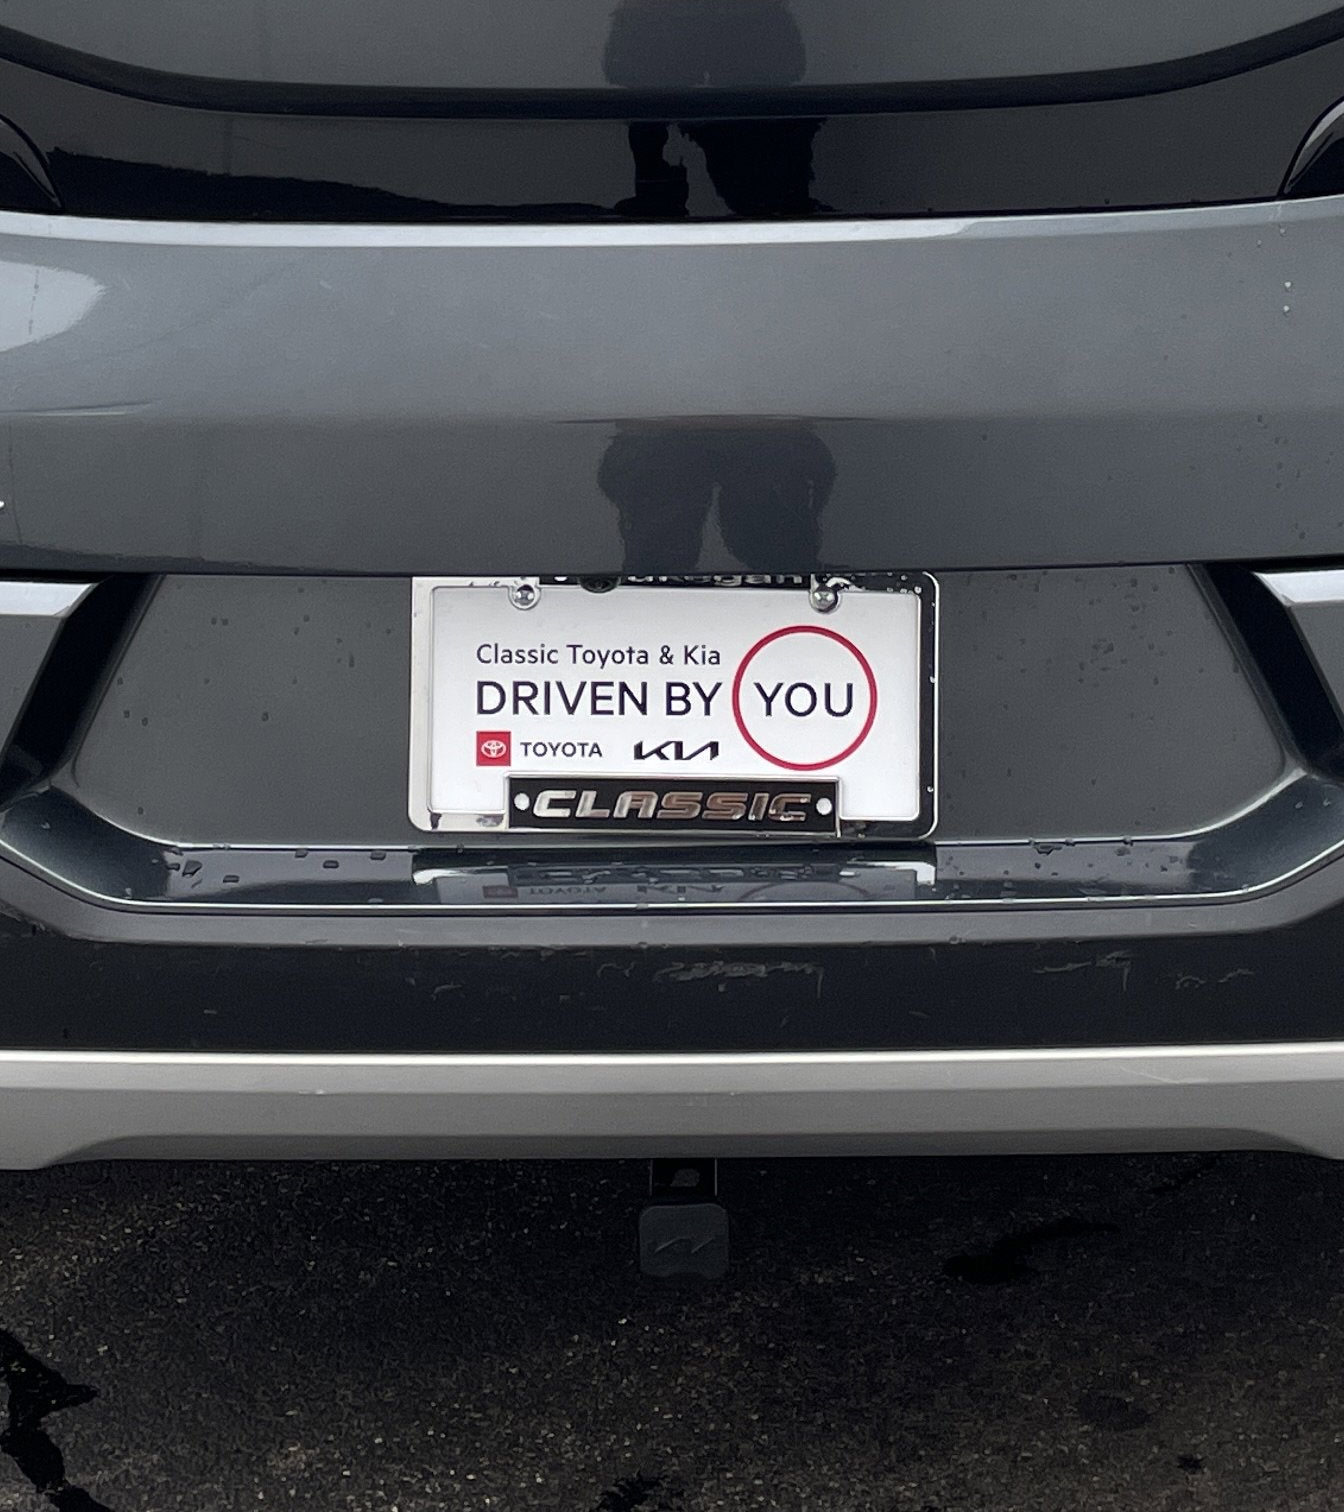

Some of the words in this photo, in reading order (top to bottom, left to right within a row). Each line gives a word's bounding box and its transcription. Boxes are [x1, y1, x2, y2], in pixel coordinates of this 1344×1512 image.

[476, 643, 559, 665] Classic
[566, 644, 649, 670] Toyota
[659, 645, 674, 665] &
[684, 645, 721, 665] Kia
[476, 680, 648, 716] DRIVEN
[665, 681, 723, 717] BY
[754, 682, 853, 718] YOU
[519, 741, 603, 758] TOYOTA
[633, 741, 719, 761] KIA
[532, 790, 811, 821] CLASSIC
